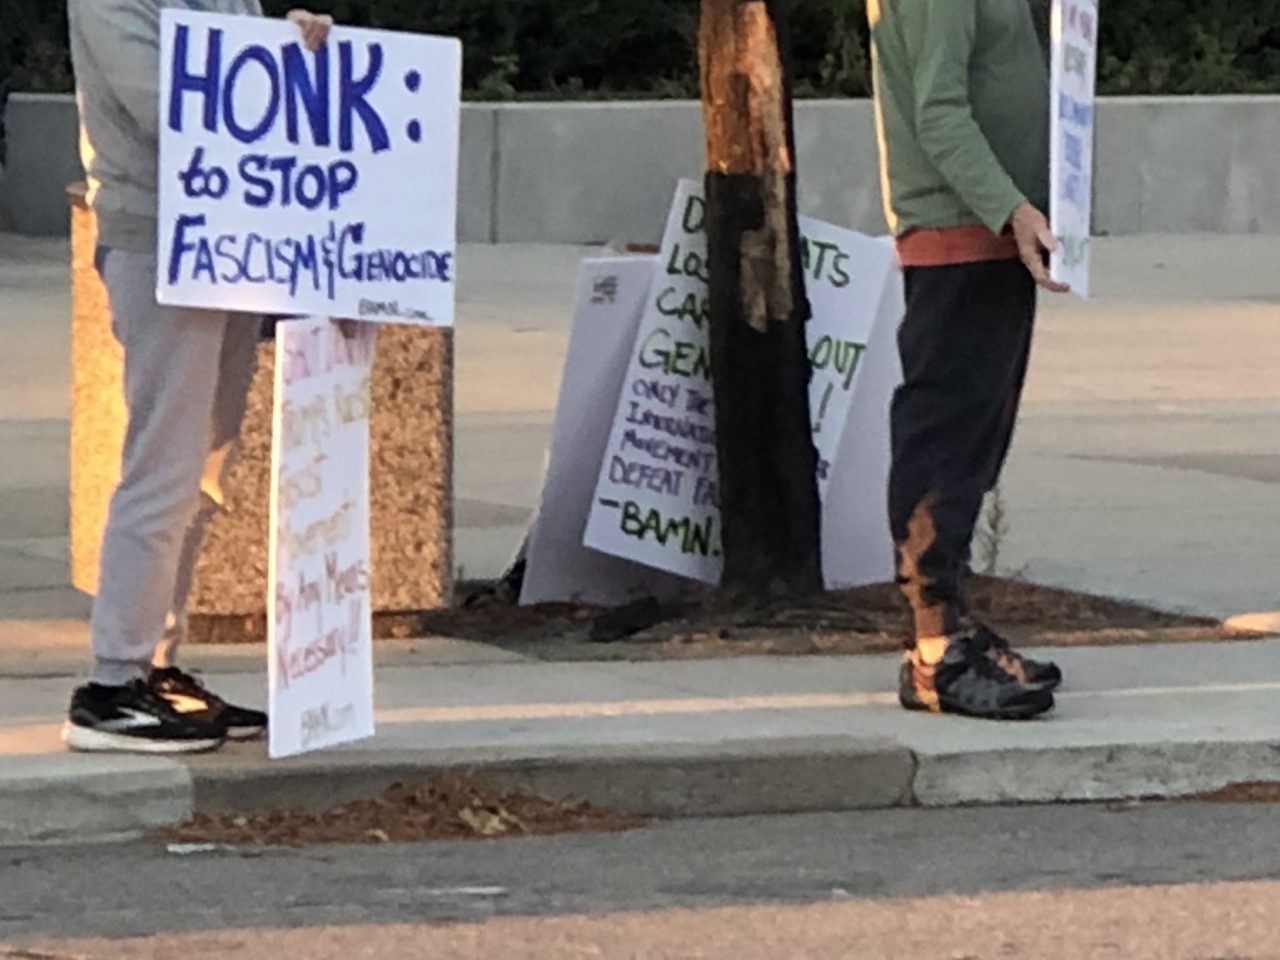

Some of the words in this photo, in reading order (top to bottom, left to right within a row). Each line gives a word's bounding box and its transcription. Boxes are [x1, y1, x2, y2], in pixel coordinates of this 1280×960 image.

[168, 23, 422, 153] HONK:
[177, 146, 229, 199] to
[238, 154, 359, 210] STOP
[609, 454, 684, 496] DEFEAT
